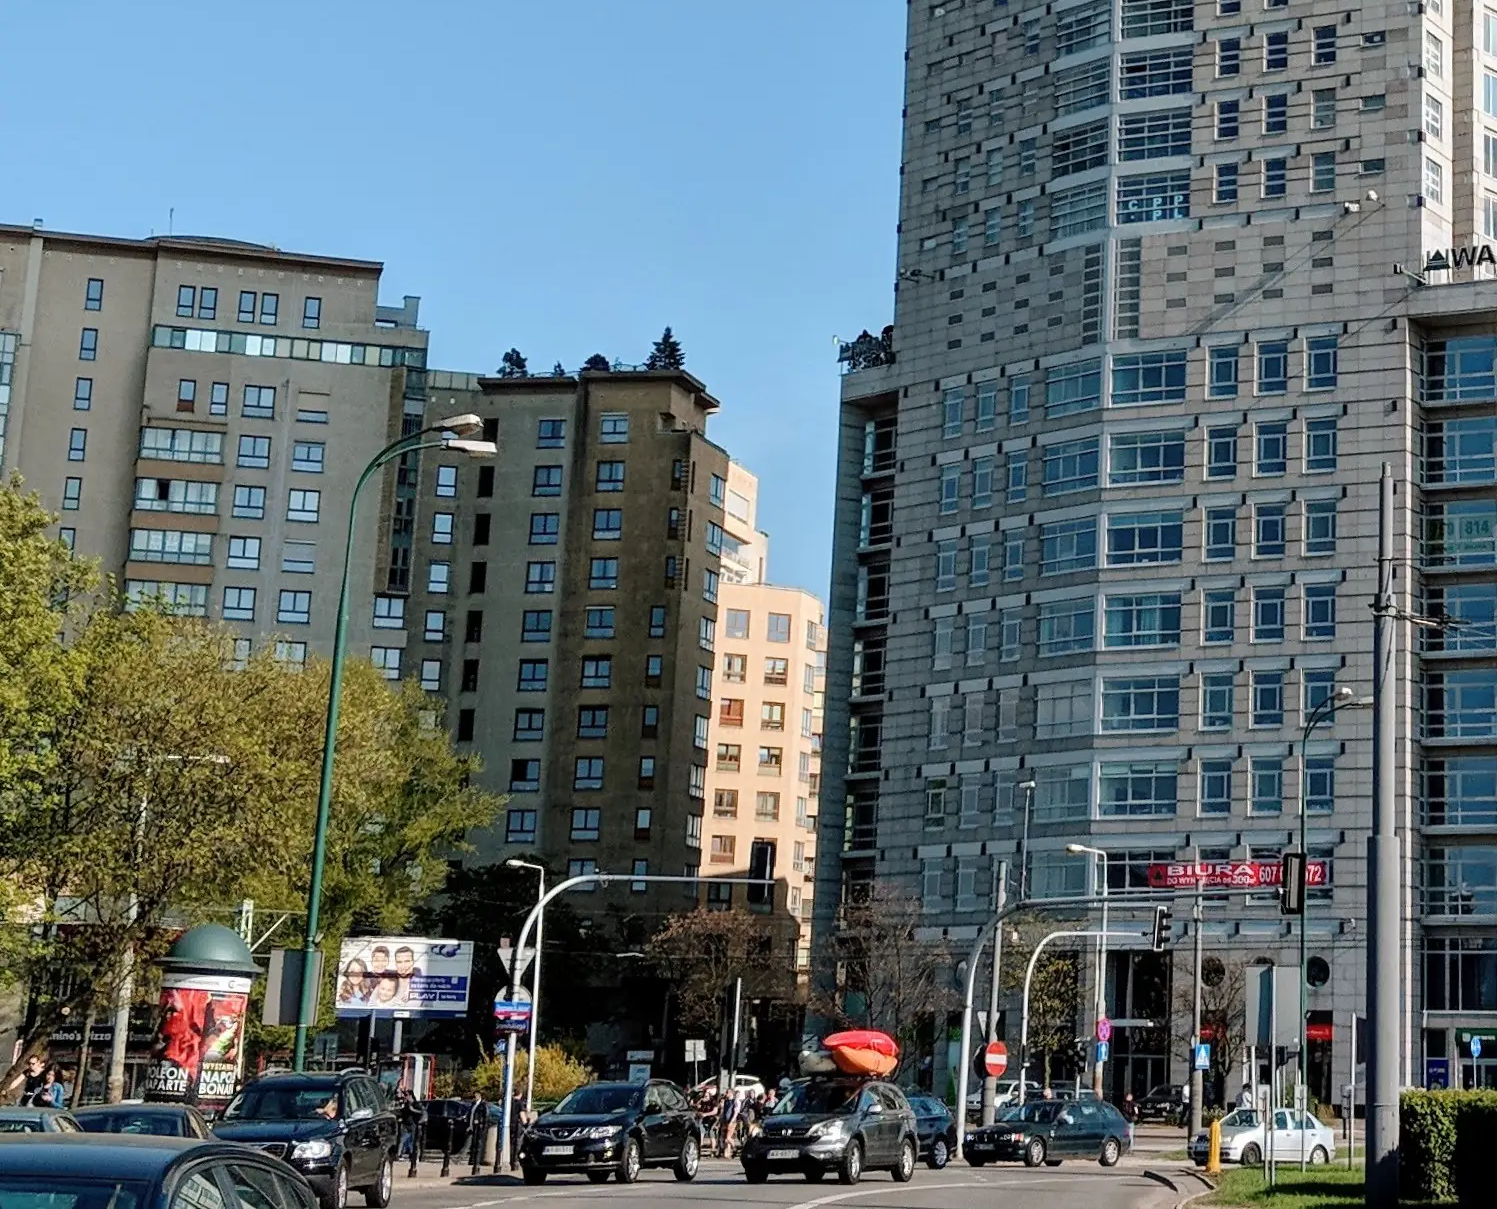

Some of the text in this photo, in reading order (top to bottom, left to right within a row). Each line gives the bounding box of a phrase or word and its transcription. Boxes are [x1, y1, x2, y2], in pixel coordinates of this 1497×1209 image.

[1167, 864, 1254, 876] BIURA
[1259, 865, 1278, 882] 607
[1167, 876, 1178, 885] DO
[410, 992, 435, 1001] PLAY
